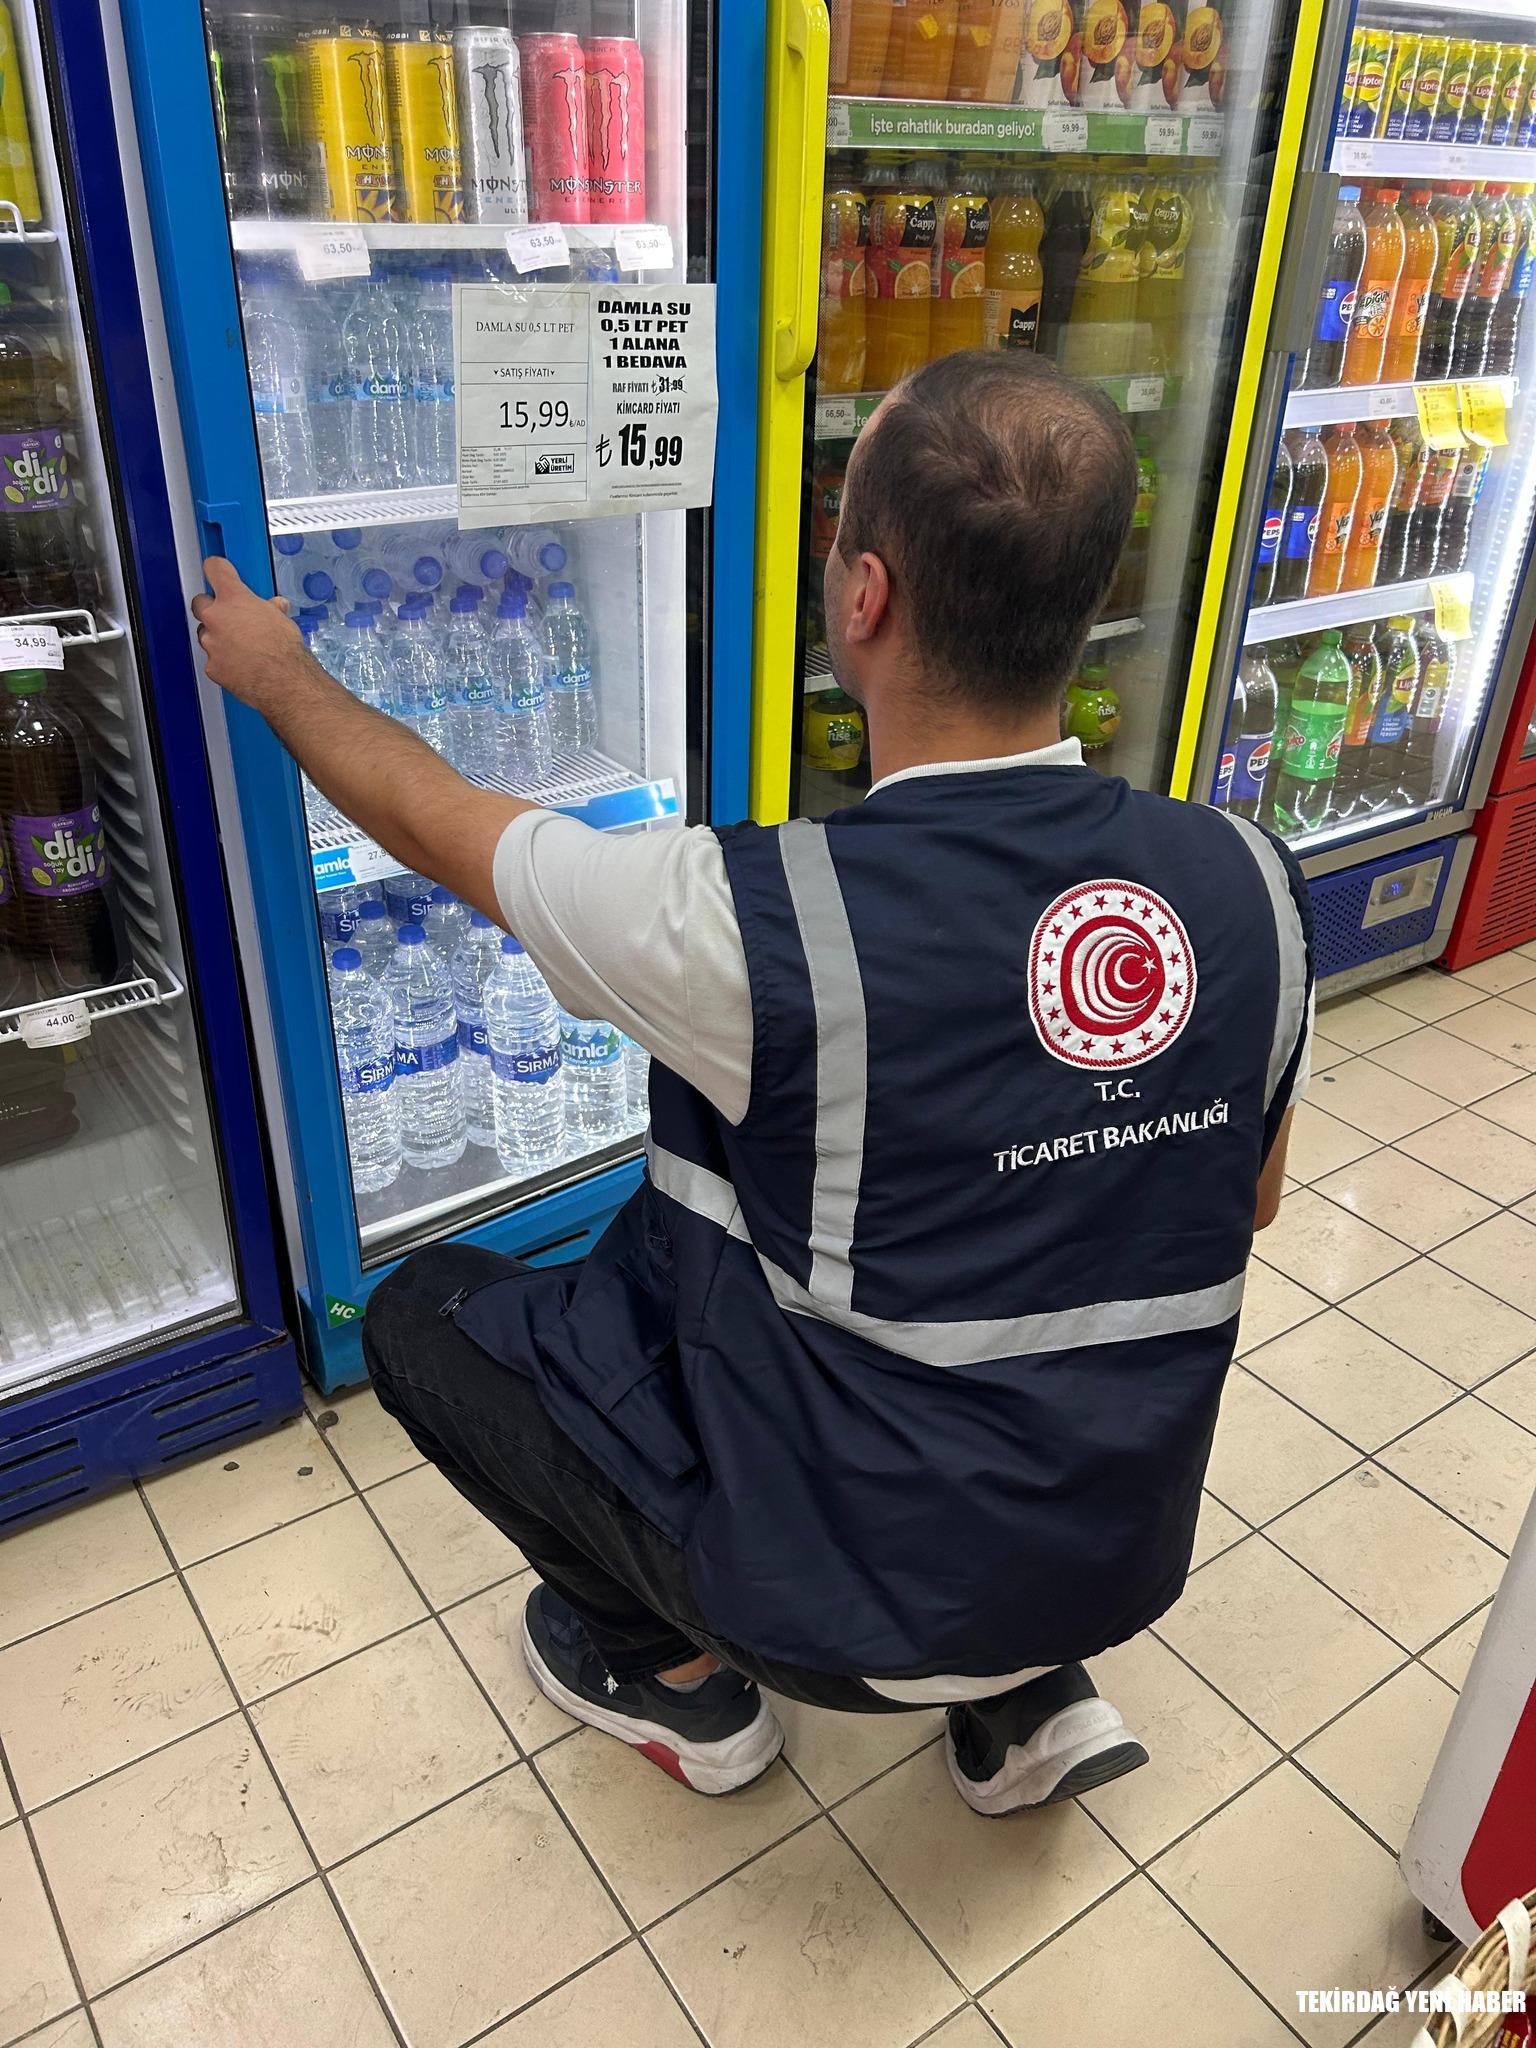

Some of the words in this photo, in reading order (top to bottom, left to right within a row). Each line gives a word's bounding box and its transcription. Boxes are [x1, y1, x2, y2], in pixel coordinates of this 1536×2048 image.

[870, 114, 894, 137] İşte
[897, 120, 943, 136] rahatlık
[946, 122, 995, 136] buradan
[997, 124, 1036, 138] geliyo!
[529, 235, 555, 248] 63,50
[323, 243, 352, 255] 63,50
[598, 300, 663, 316] DAMLA
[667, 302, 691, 316] SU
[476, 320, 513, 333] DAMLA
[515, 321, 527, 332] SU
[528, 321, 541, 334] 0,5
[544, 322, 556, 333] LT
[558, 322, 575, 333] PET
[600, 318, 629, 334] 0,5
[635, 319, 653, 333] LT
[656, 320, 689, 333] PET
[1012, 320, 1036, 331] Cappy
[610, 338, 619, 350] 1
[623, 338, 680, 351] ALANA
[603, 356, 612, 369] 1
[616, 356, 687, 369] BEDAVA
[500, 368, 522, 380] SATIŞ
[524, 367, 549, 378] FİYATI
[612, 383, 626, 393] RAF
[628, 381, 649, 393] FİYATI
[616, 400, 653, 415] KİMCARD
[656, 399, 680, 414] FİYATI
[499, 400, 569, 434] 15,99
[618, 423, 683, 470] 15,99
[550, 456, 568, 464] YERLİ
[550, 464, 573, 472] ÜRETİM
[14, 638, 47, 648] 34,99
[368, 850, 389, 861] 27,9
[314, 856, 350, 875] amla
[46, 1013, 75, 1027] 44,00
[561, 1041, 609, 1058] amla
[517, 1051, 559, 1074] SIRMA
[1094, 1078, 1141, 1102] T.C.
[993, 1129, 1099, 1173] TİCARET
[1103, 1097, 1230, 1149] BAKANLIĞI
[329, 1302, 356, 1319] HC
